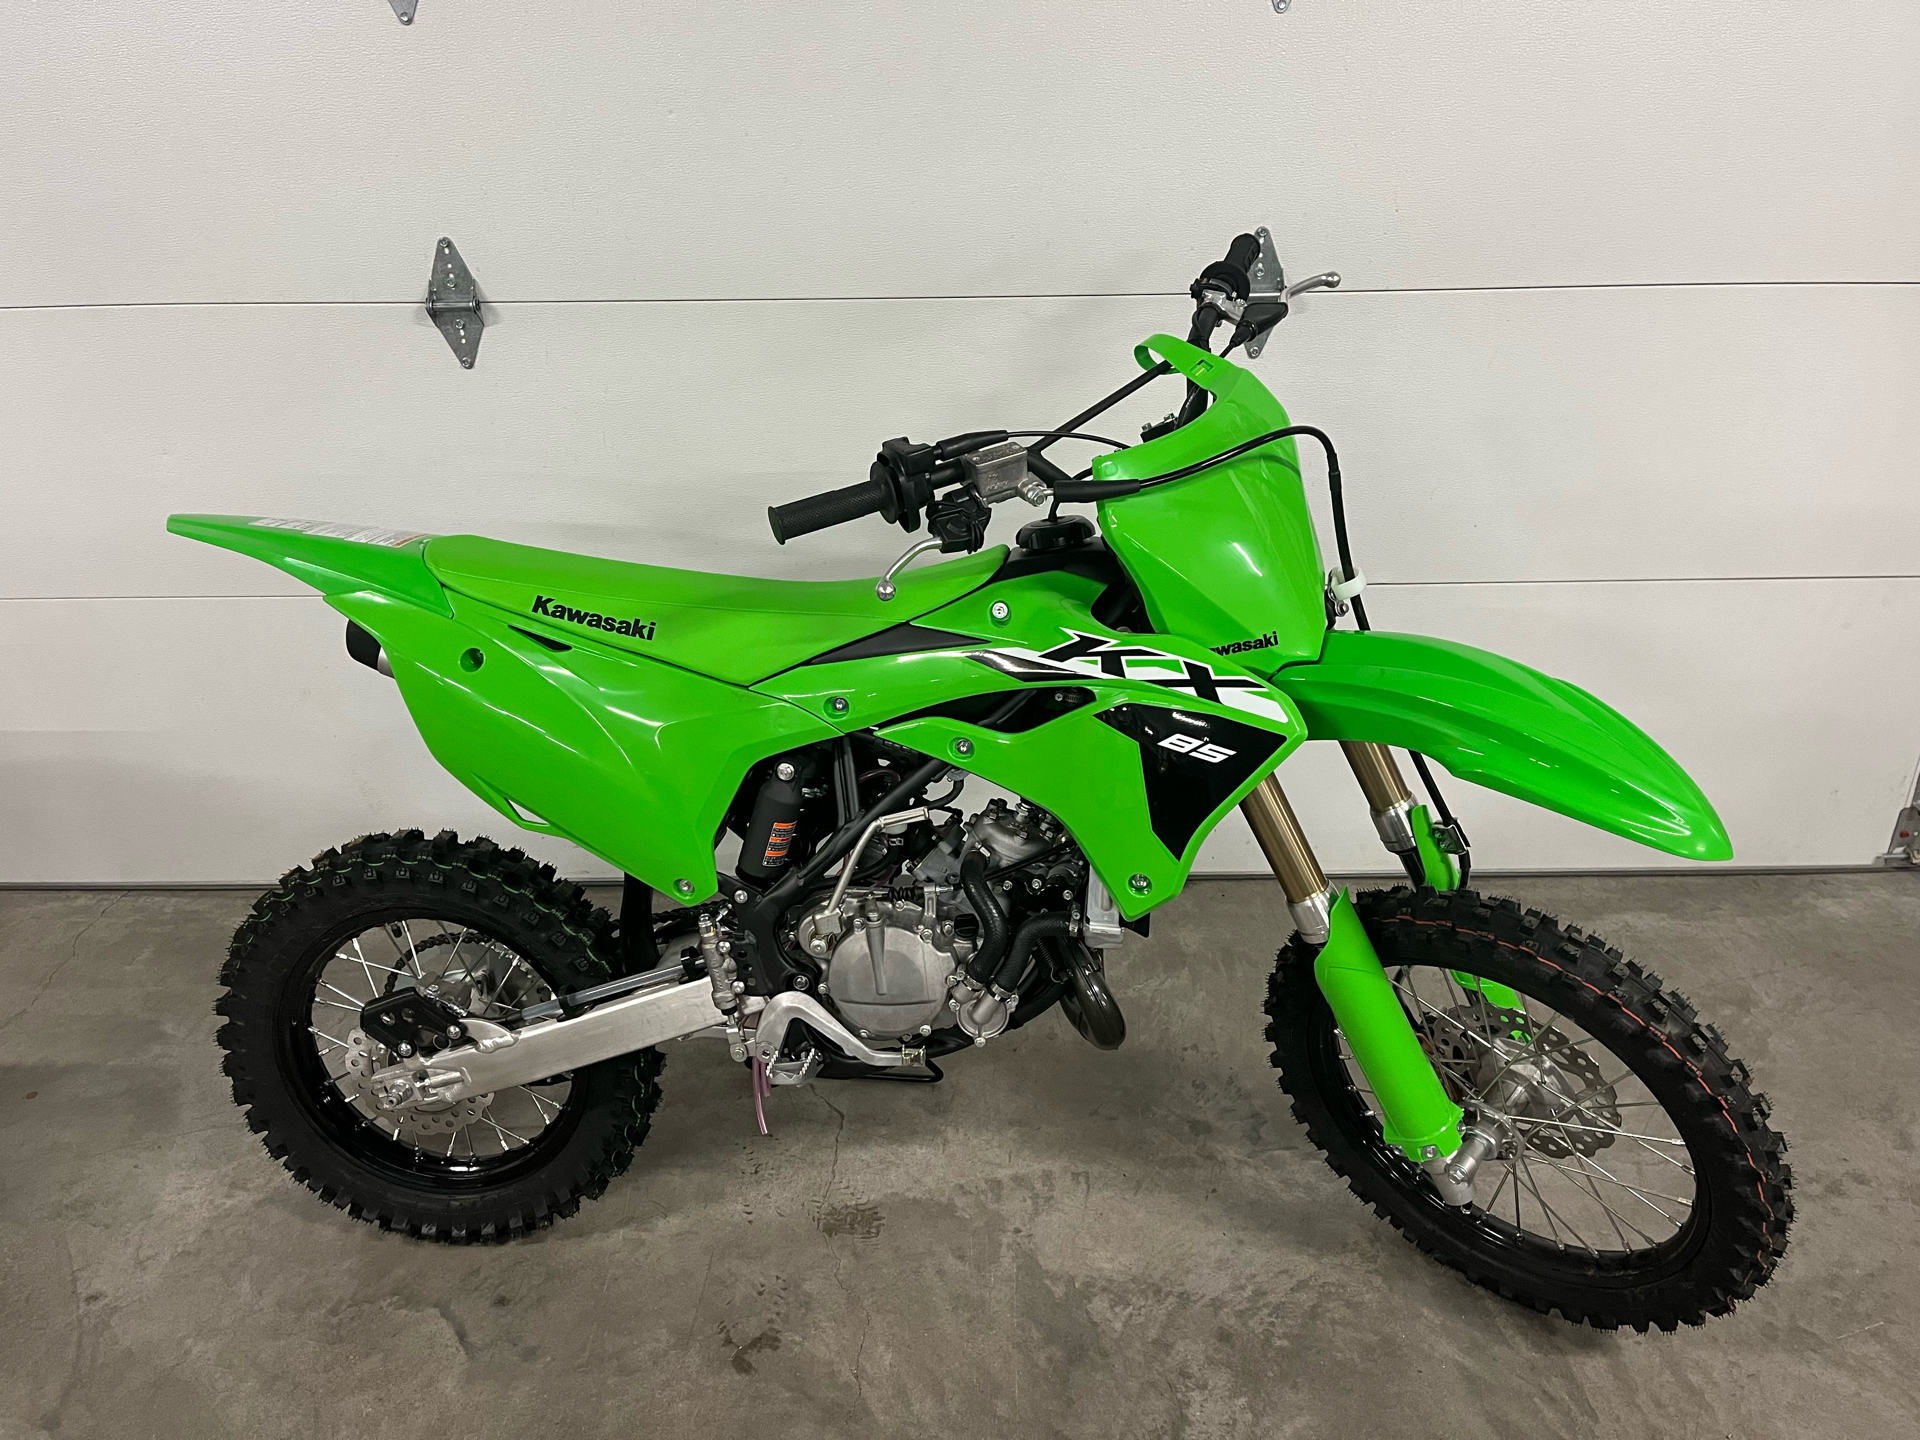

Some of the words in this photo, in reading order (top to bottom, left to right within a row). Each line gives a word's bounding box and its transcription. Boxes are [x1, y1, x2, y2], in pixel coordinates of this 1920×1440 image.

[531, 594, 657, 641] Kawasaki
[1208, 630, 1279, 657] wasaki
[1037, 627, 1270, 706] KX
[1157, 733, 1238, 764] 85
